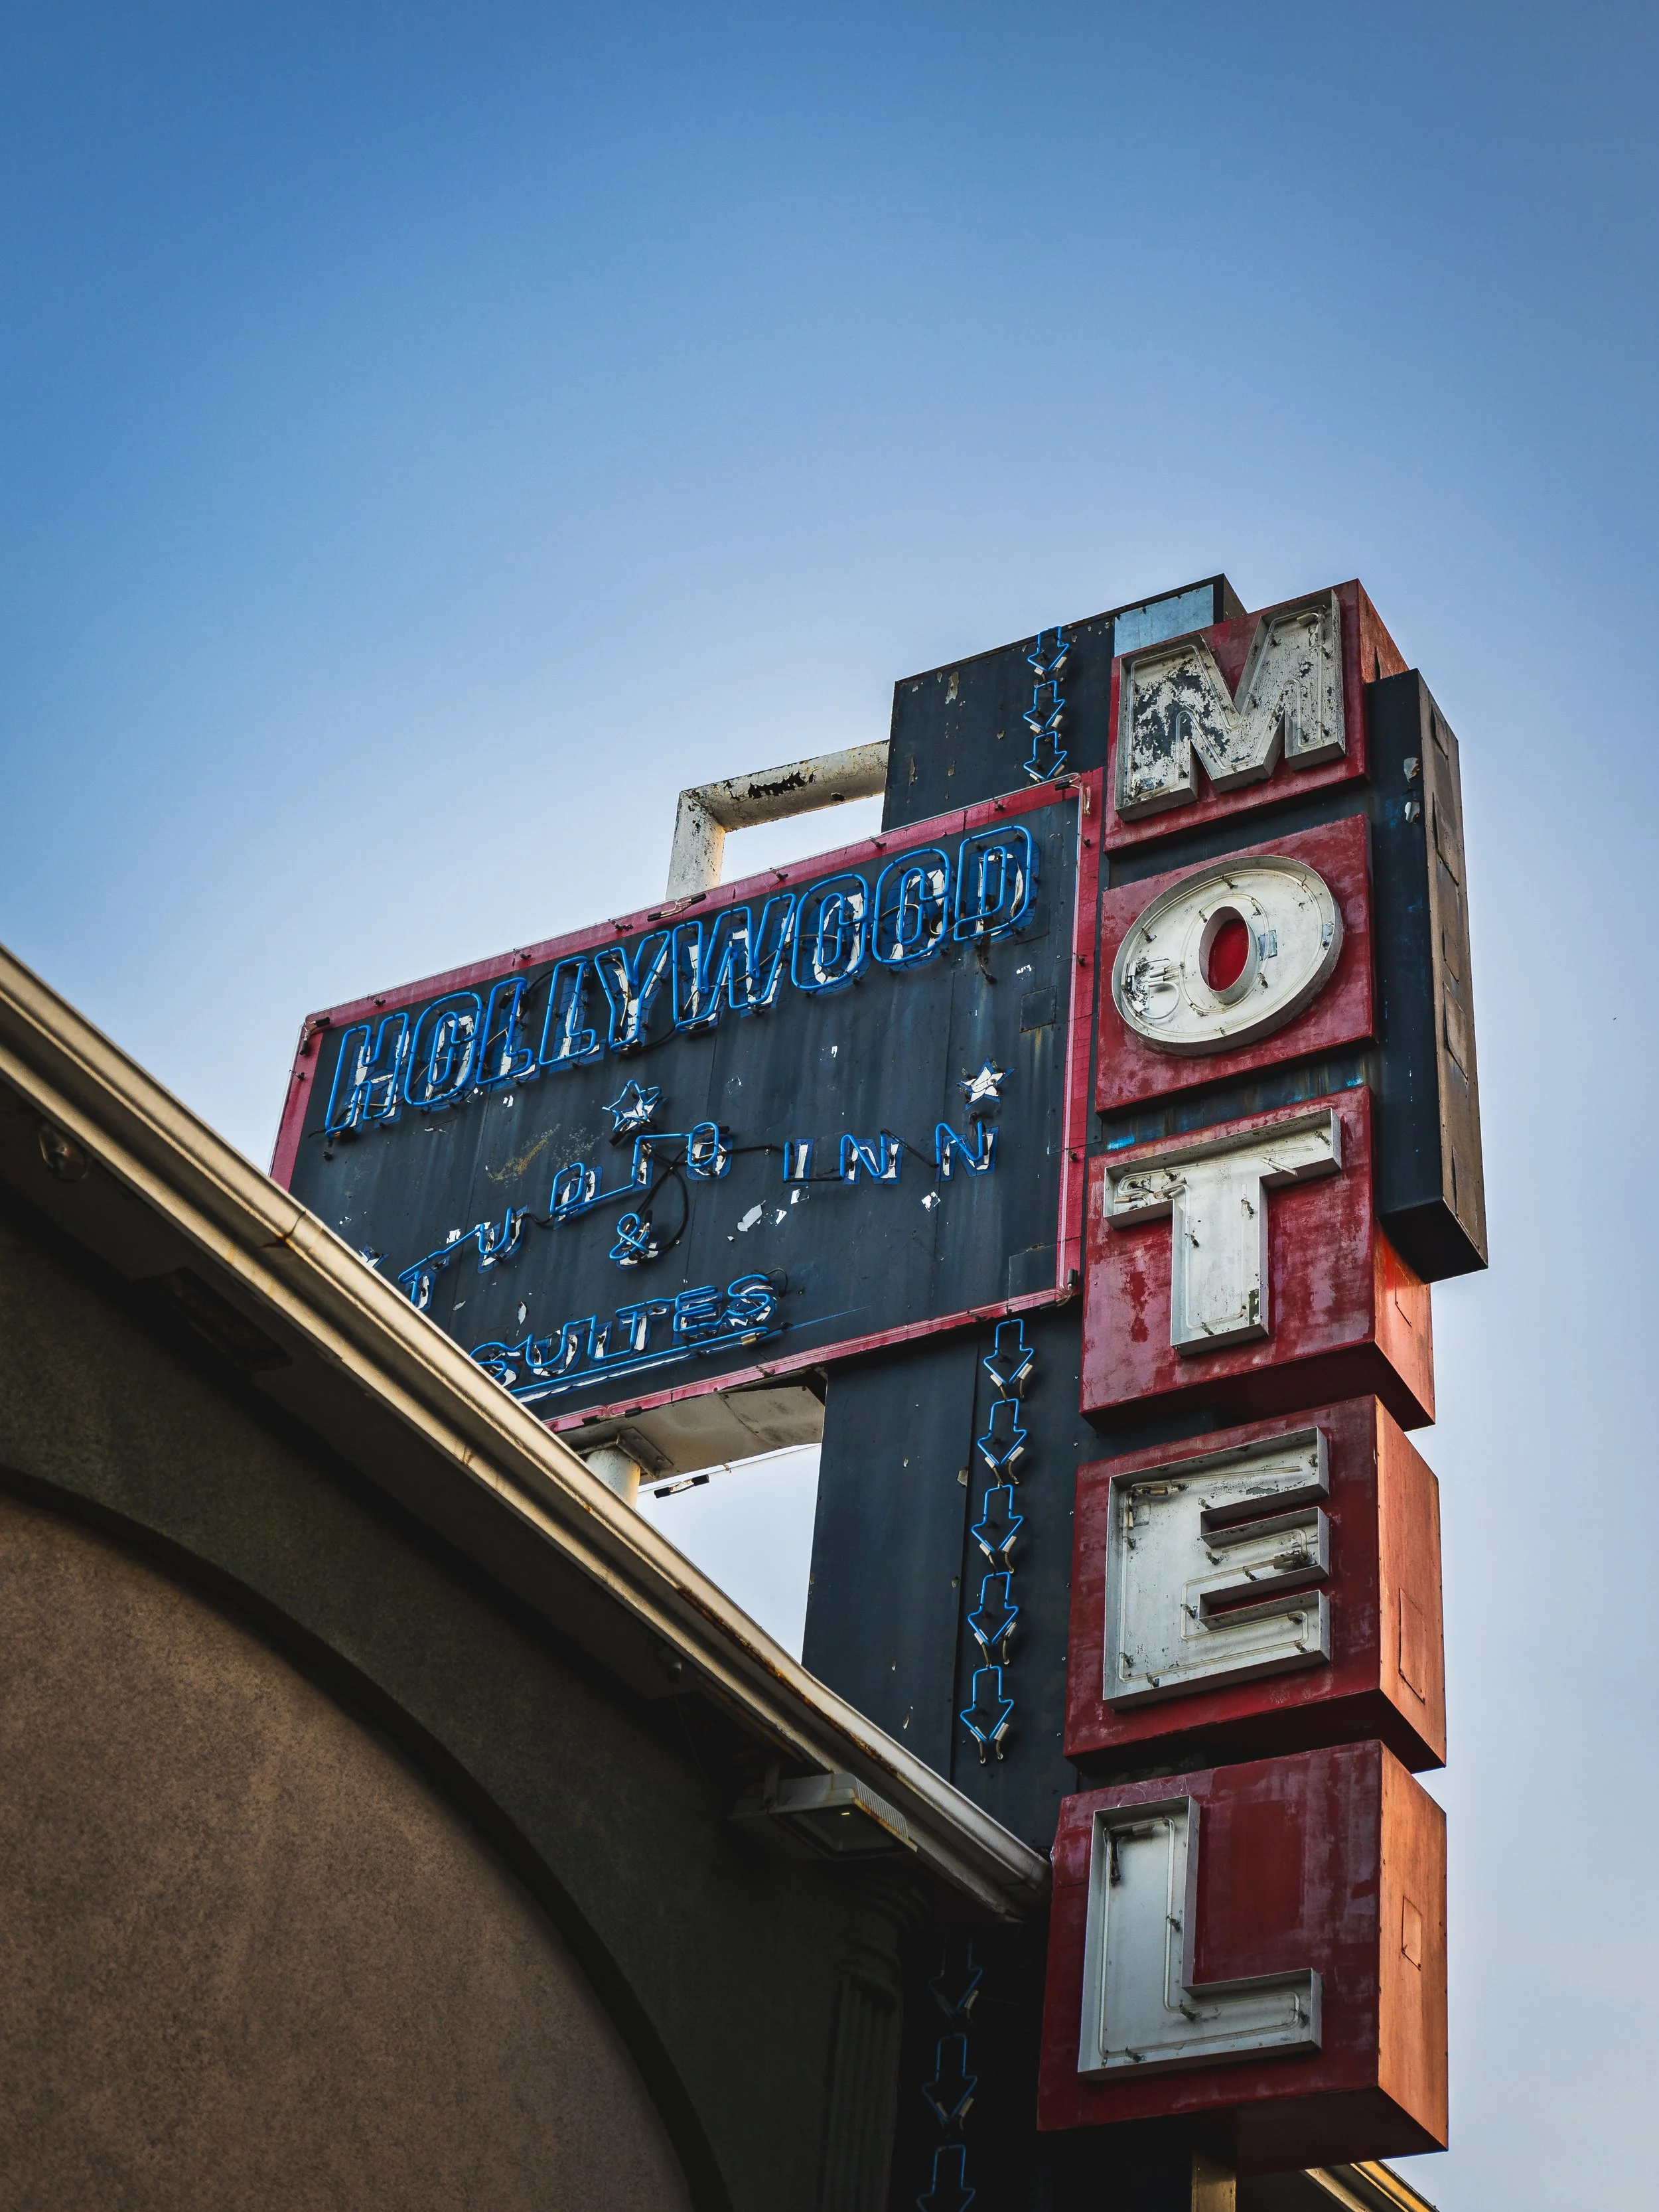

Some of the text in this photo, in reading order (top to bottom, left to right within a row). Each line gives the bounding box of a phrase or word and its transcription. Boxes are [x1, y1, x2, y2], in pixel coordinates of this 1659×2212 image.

[325, 824, 1040, 1138] HOLLYWOOD
[398, 1121, 999, 1312] TUDIO INN
[609, 1212, 662, 1271] &
[469, 1273, 778, 1388] SUITES
[1078, 589, 1346, 2081] MOTEL
